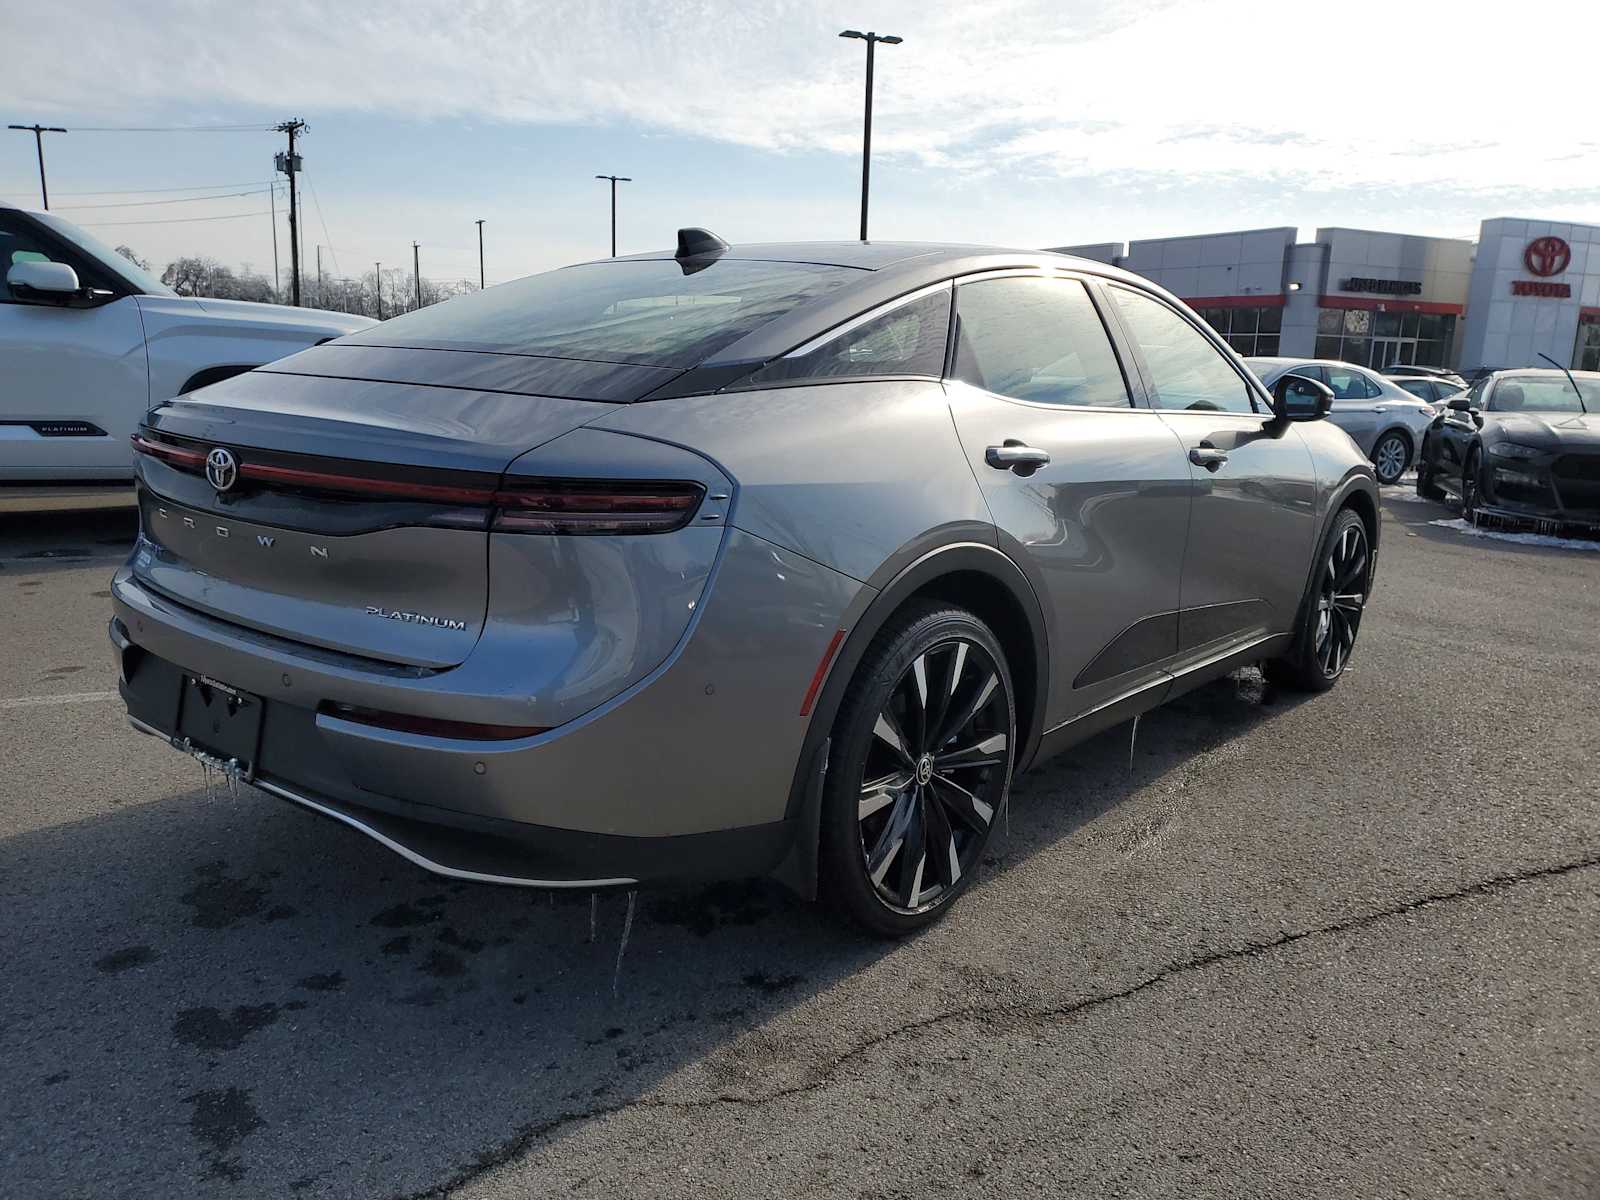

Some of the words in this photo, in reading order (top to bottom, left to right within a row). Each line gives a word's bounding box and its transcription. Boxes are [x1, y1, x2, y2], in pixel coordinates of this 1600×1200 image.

[1511, 281, 1571, 298] TOYOTA
[159, 508, 329, 559] CROWN
[365, 606, 466, 631] PLATINUM
